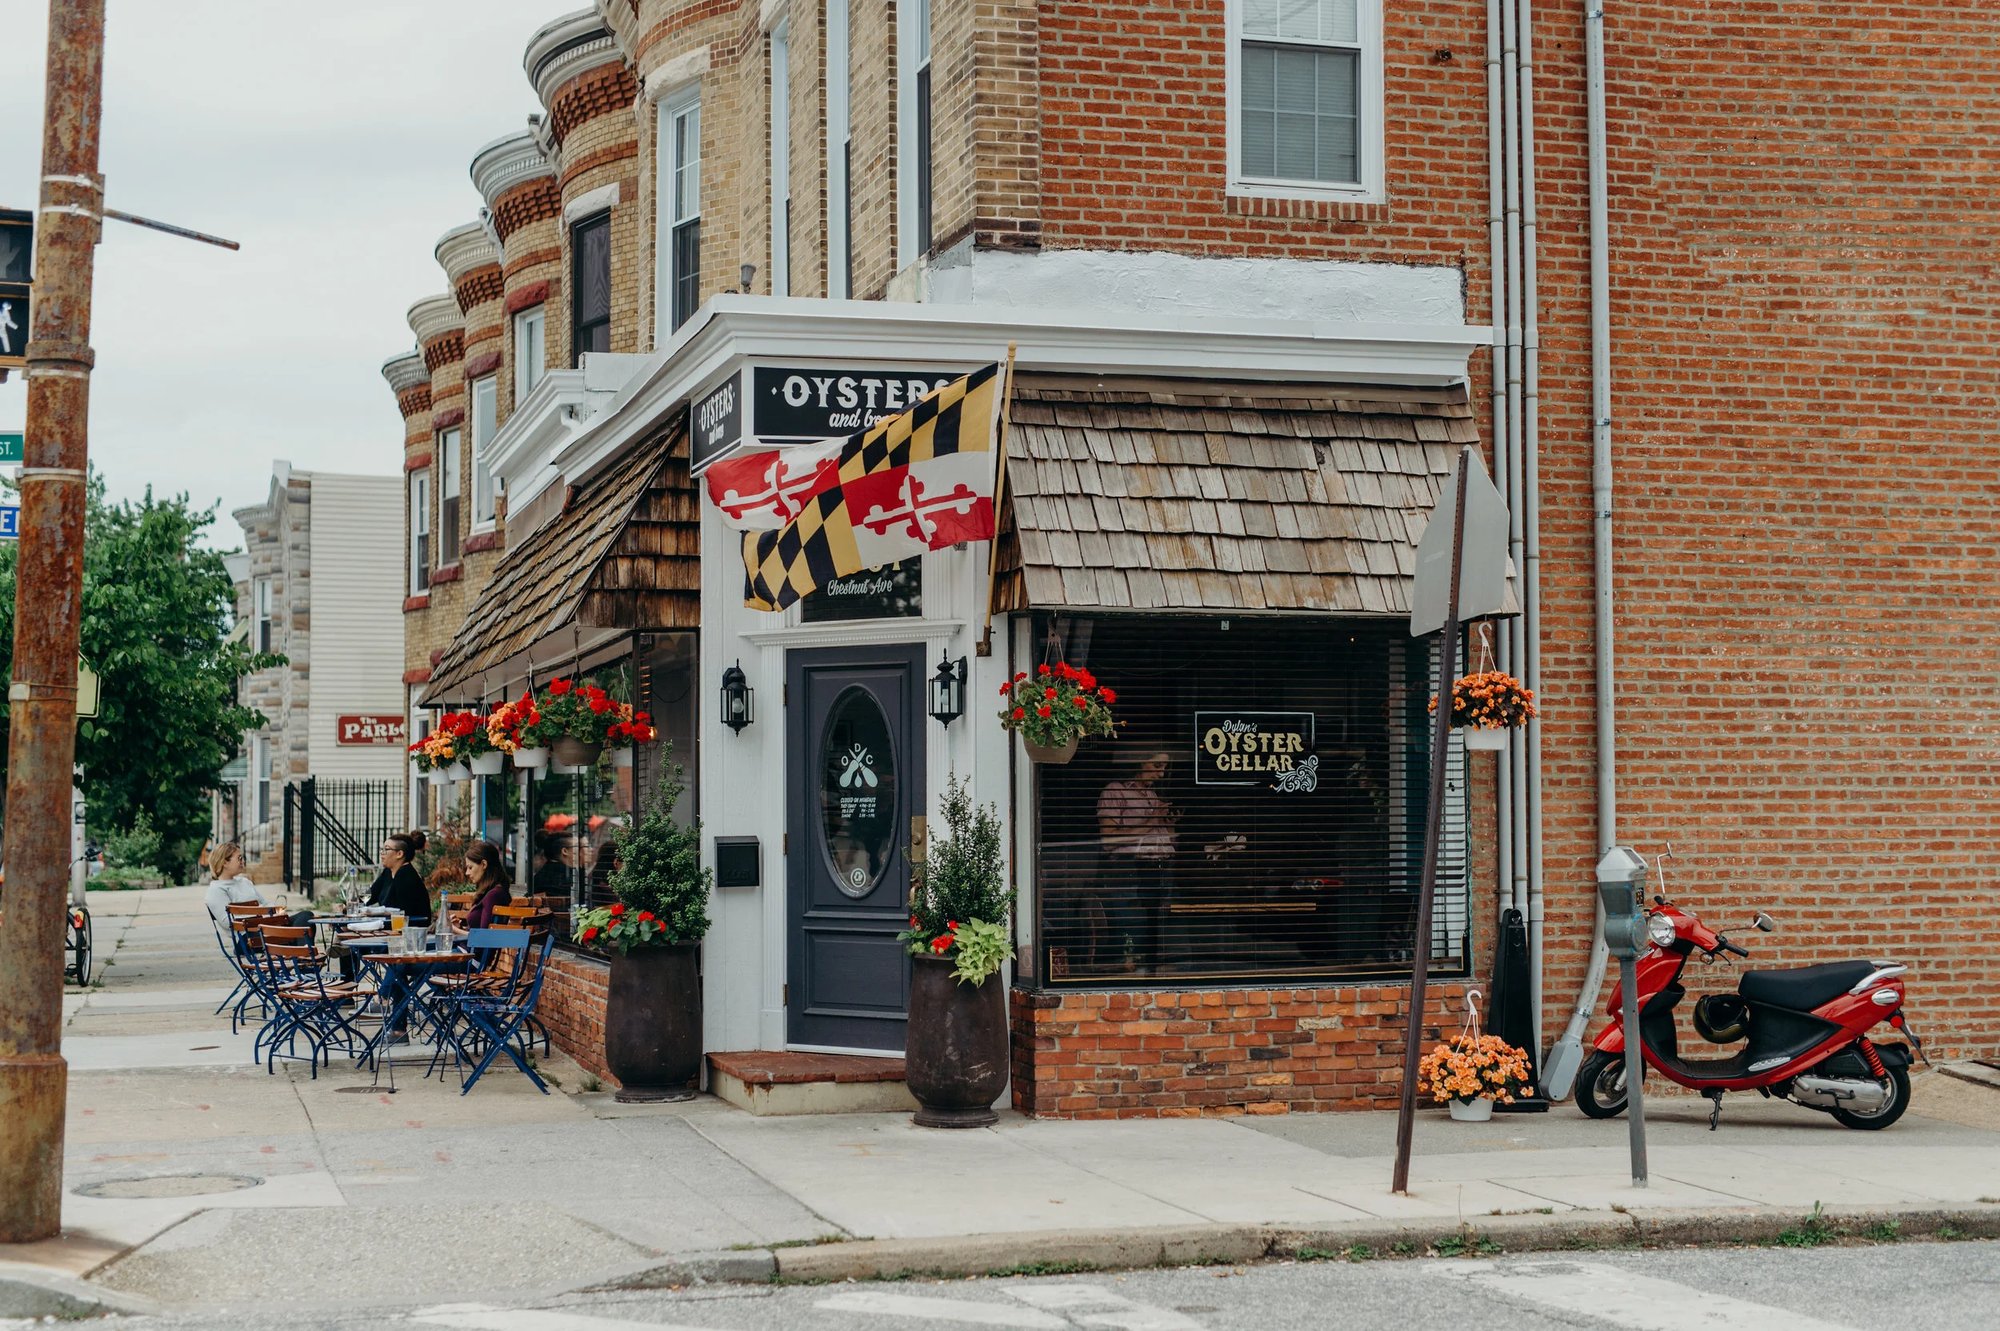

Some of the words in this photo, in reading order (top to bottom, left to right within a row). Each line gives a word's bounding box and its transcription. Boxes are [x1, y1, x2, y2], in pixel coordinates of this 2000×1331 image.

[700, 382, 733, 432] OYSTERS
[828, 408, 862, 428] and
[827, 579, 870, 597] Chestnut
[870, 577, 893, 595] Ave
[360, 717, 377, 725] The
[1222, 719, 1258, 733] Dylan's
[854, 743, 861, 753] D
[1203, 727, 1304, 755] OYSTER
[841, 755, 849, 767] O
[865, 754, 874, 765] C
[1215, 753, 1296, 772] CELLAR
